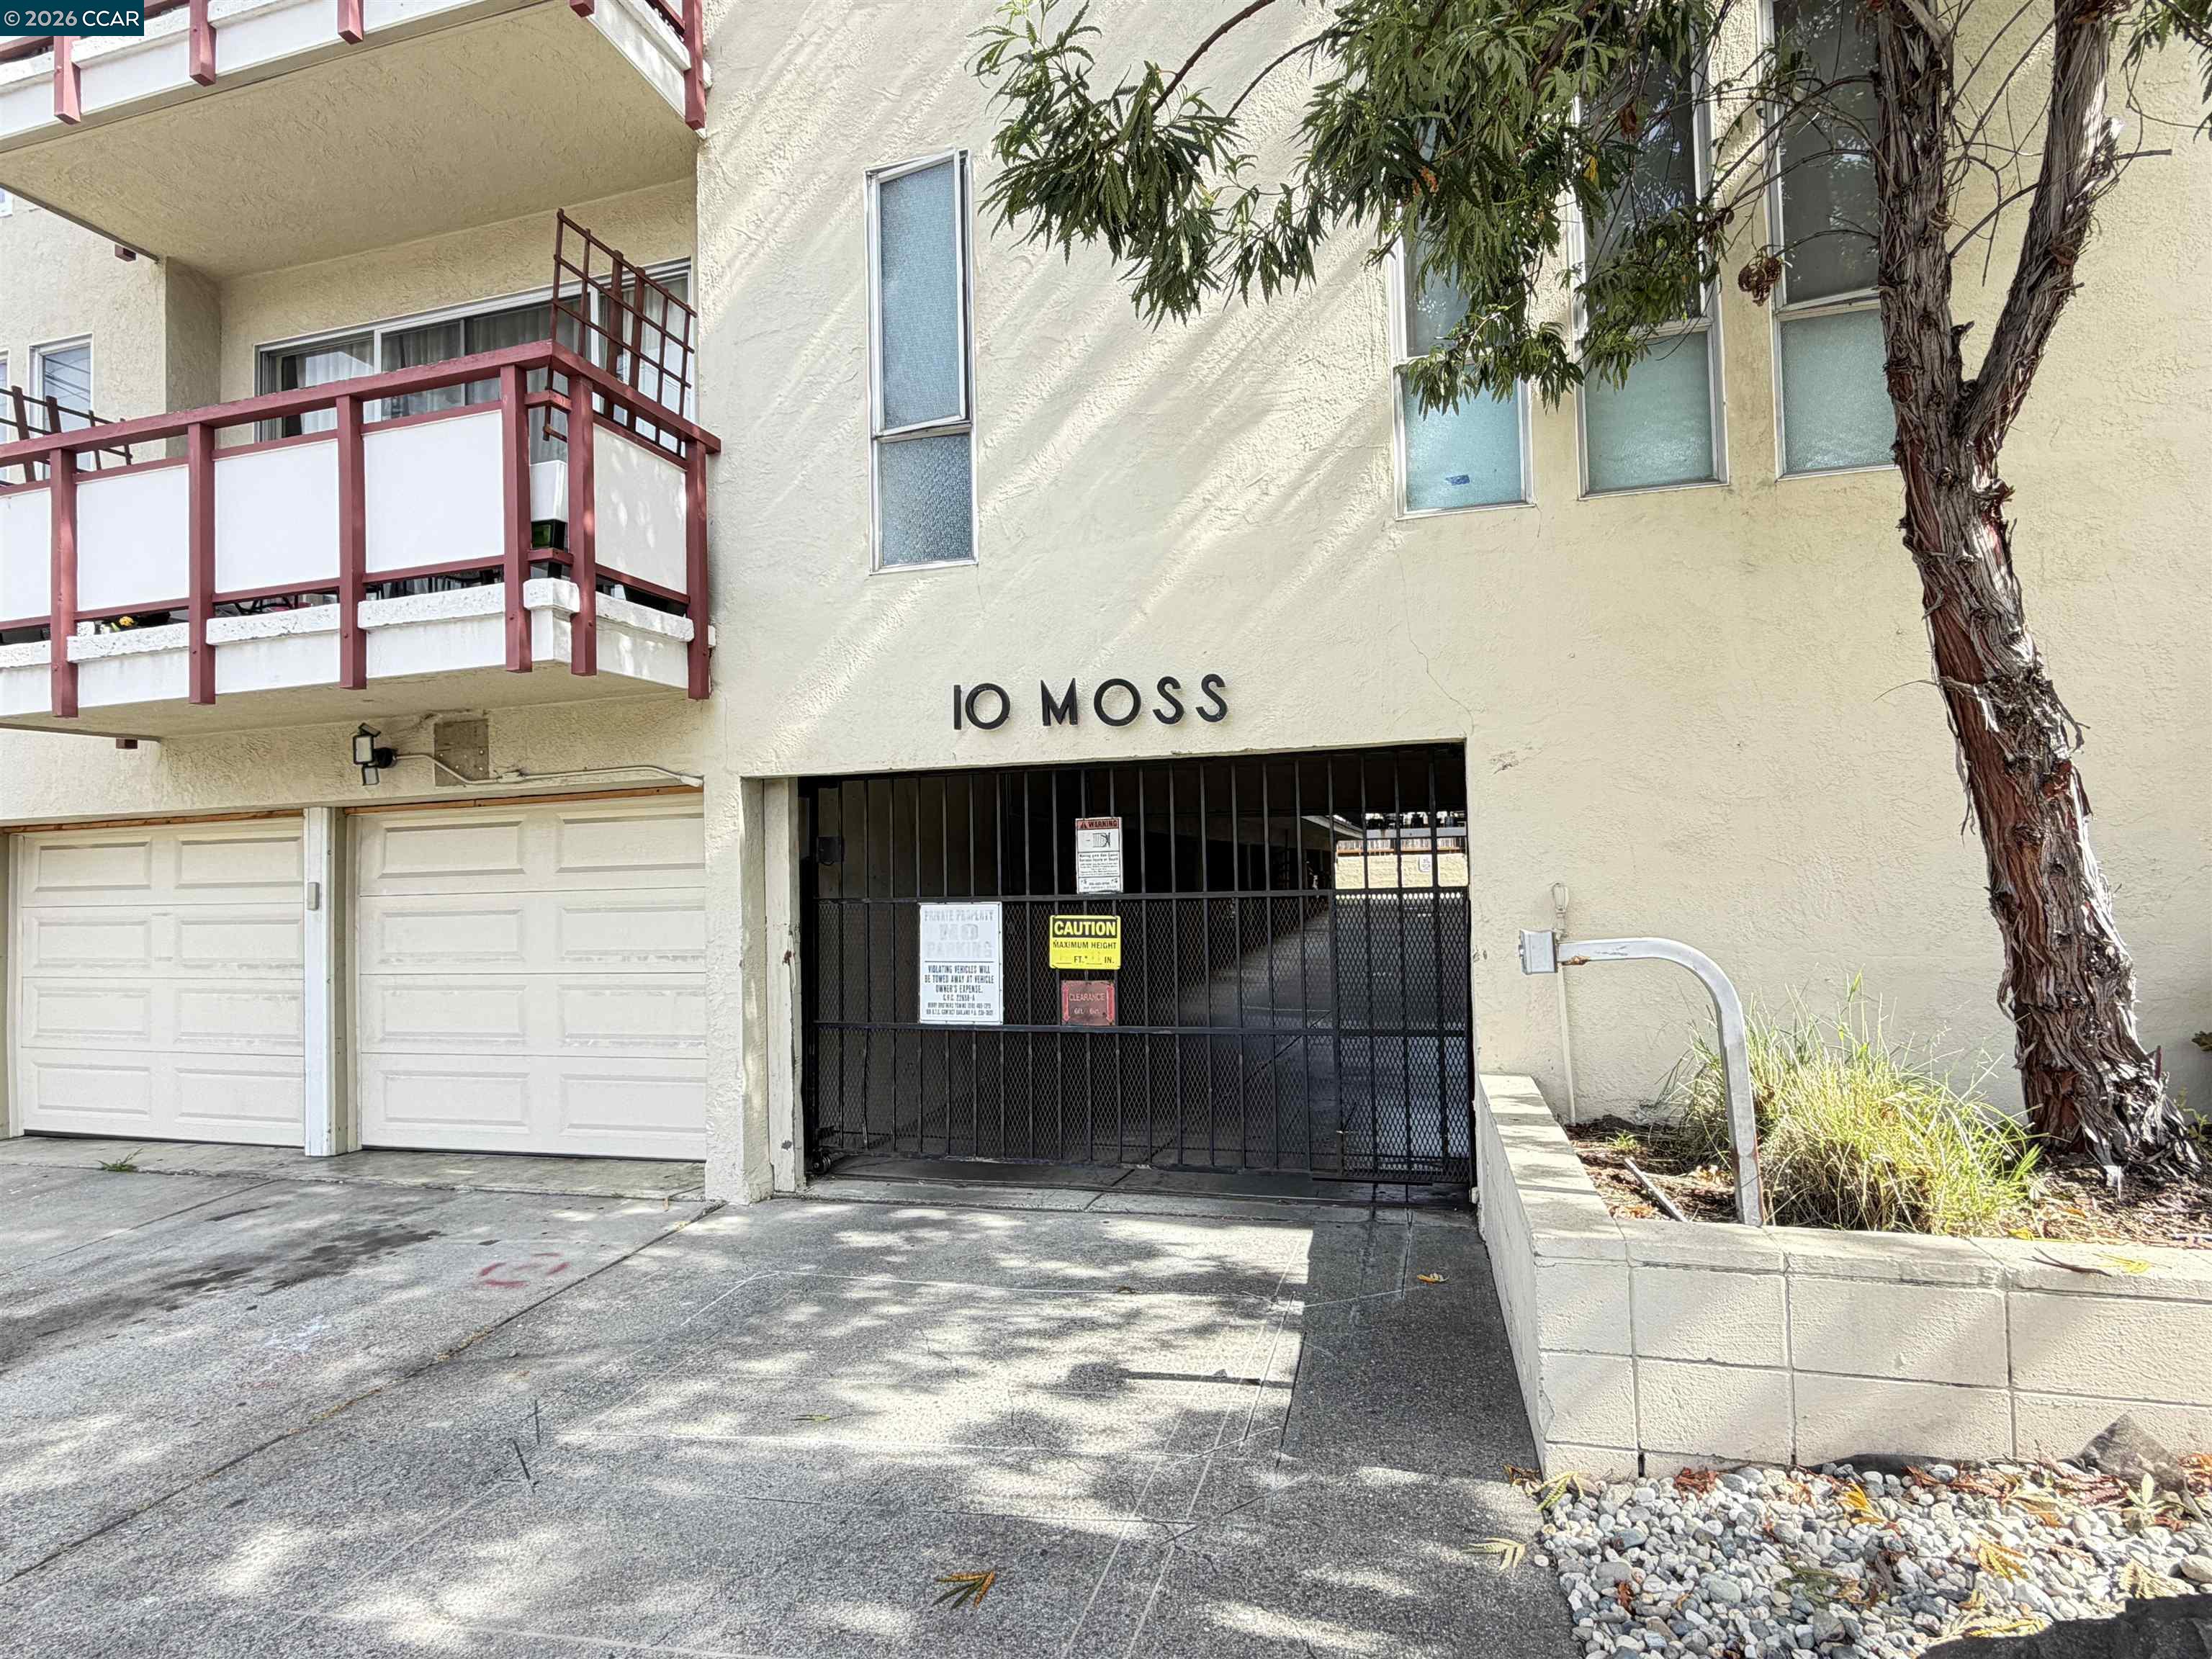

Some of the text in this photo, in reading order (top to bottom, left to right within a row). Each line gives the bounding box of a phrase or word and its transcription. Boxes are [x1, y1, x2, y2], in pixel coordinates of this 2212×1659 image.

[953, 673, 1228, 729] 10 MOSS
[925, 909, 994, 922] PRIVATE PROPERTY
[1053, 921, 1116, 936] CAUTION
[1053, 940, 1117, 950] MAXIMUM HEIGHT
[927, 965, 990, 974] VIOLATING VEHICLES WILL
[932, 975, 948, 984] TOWED
[950, 975, 964, 984] AWAY
[974, 975, 994, 984] VEHICLE
[935, 984, 958, 993] OWNER'S
[1069, 993, 1106, 1002] CLEARANCE
